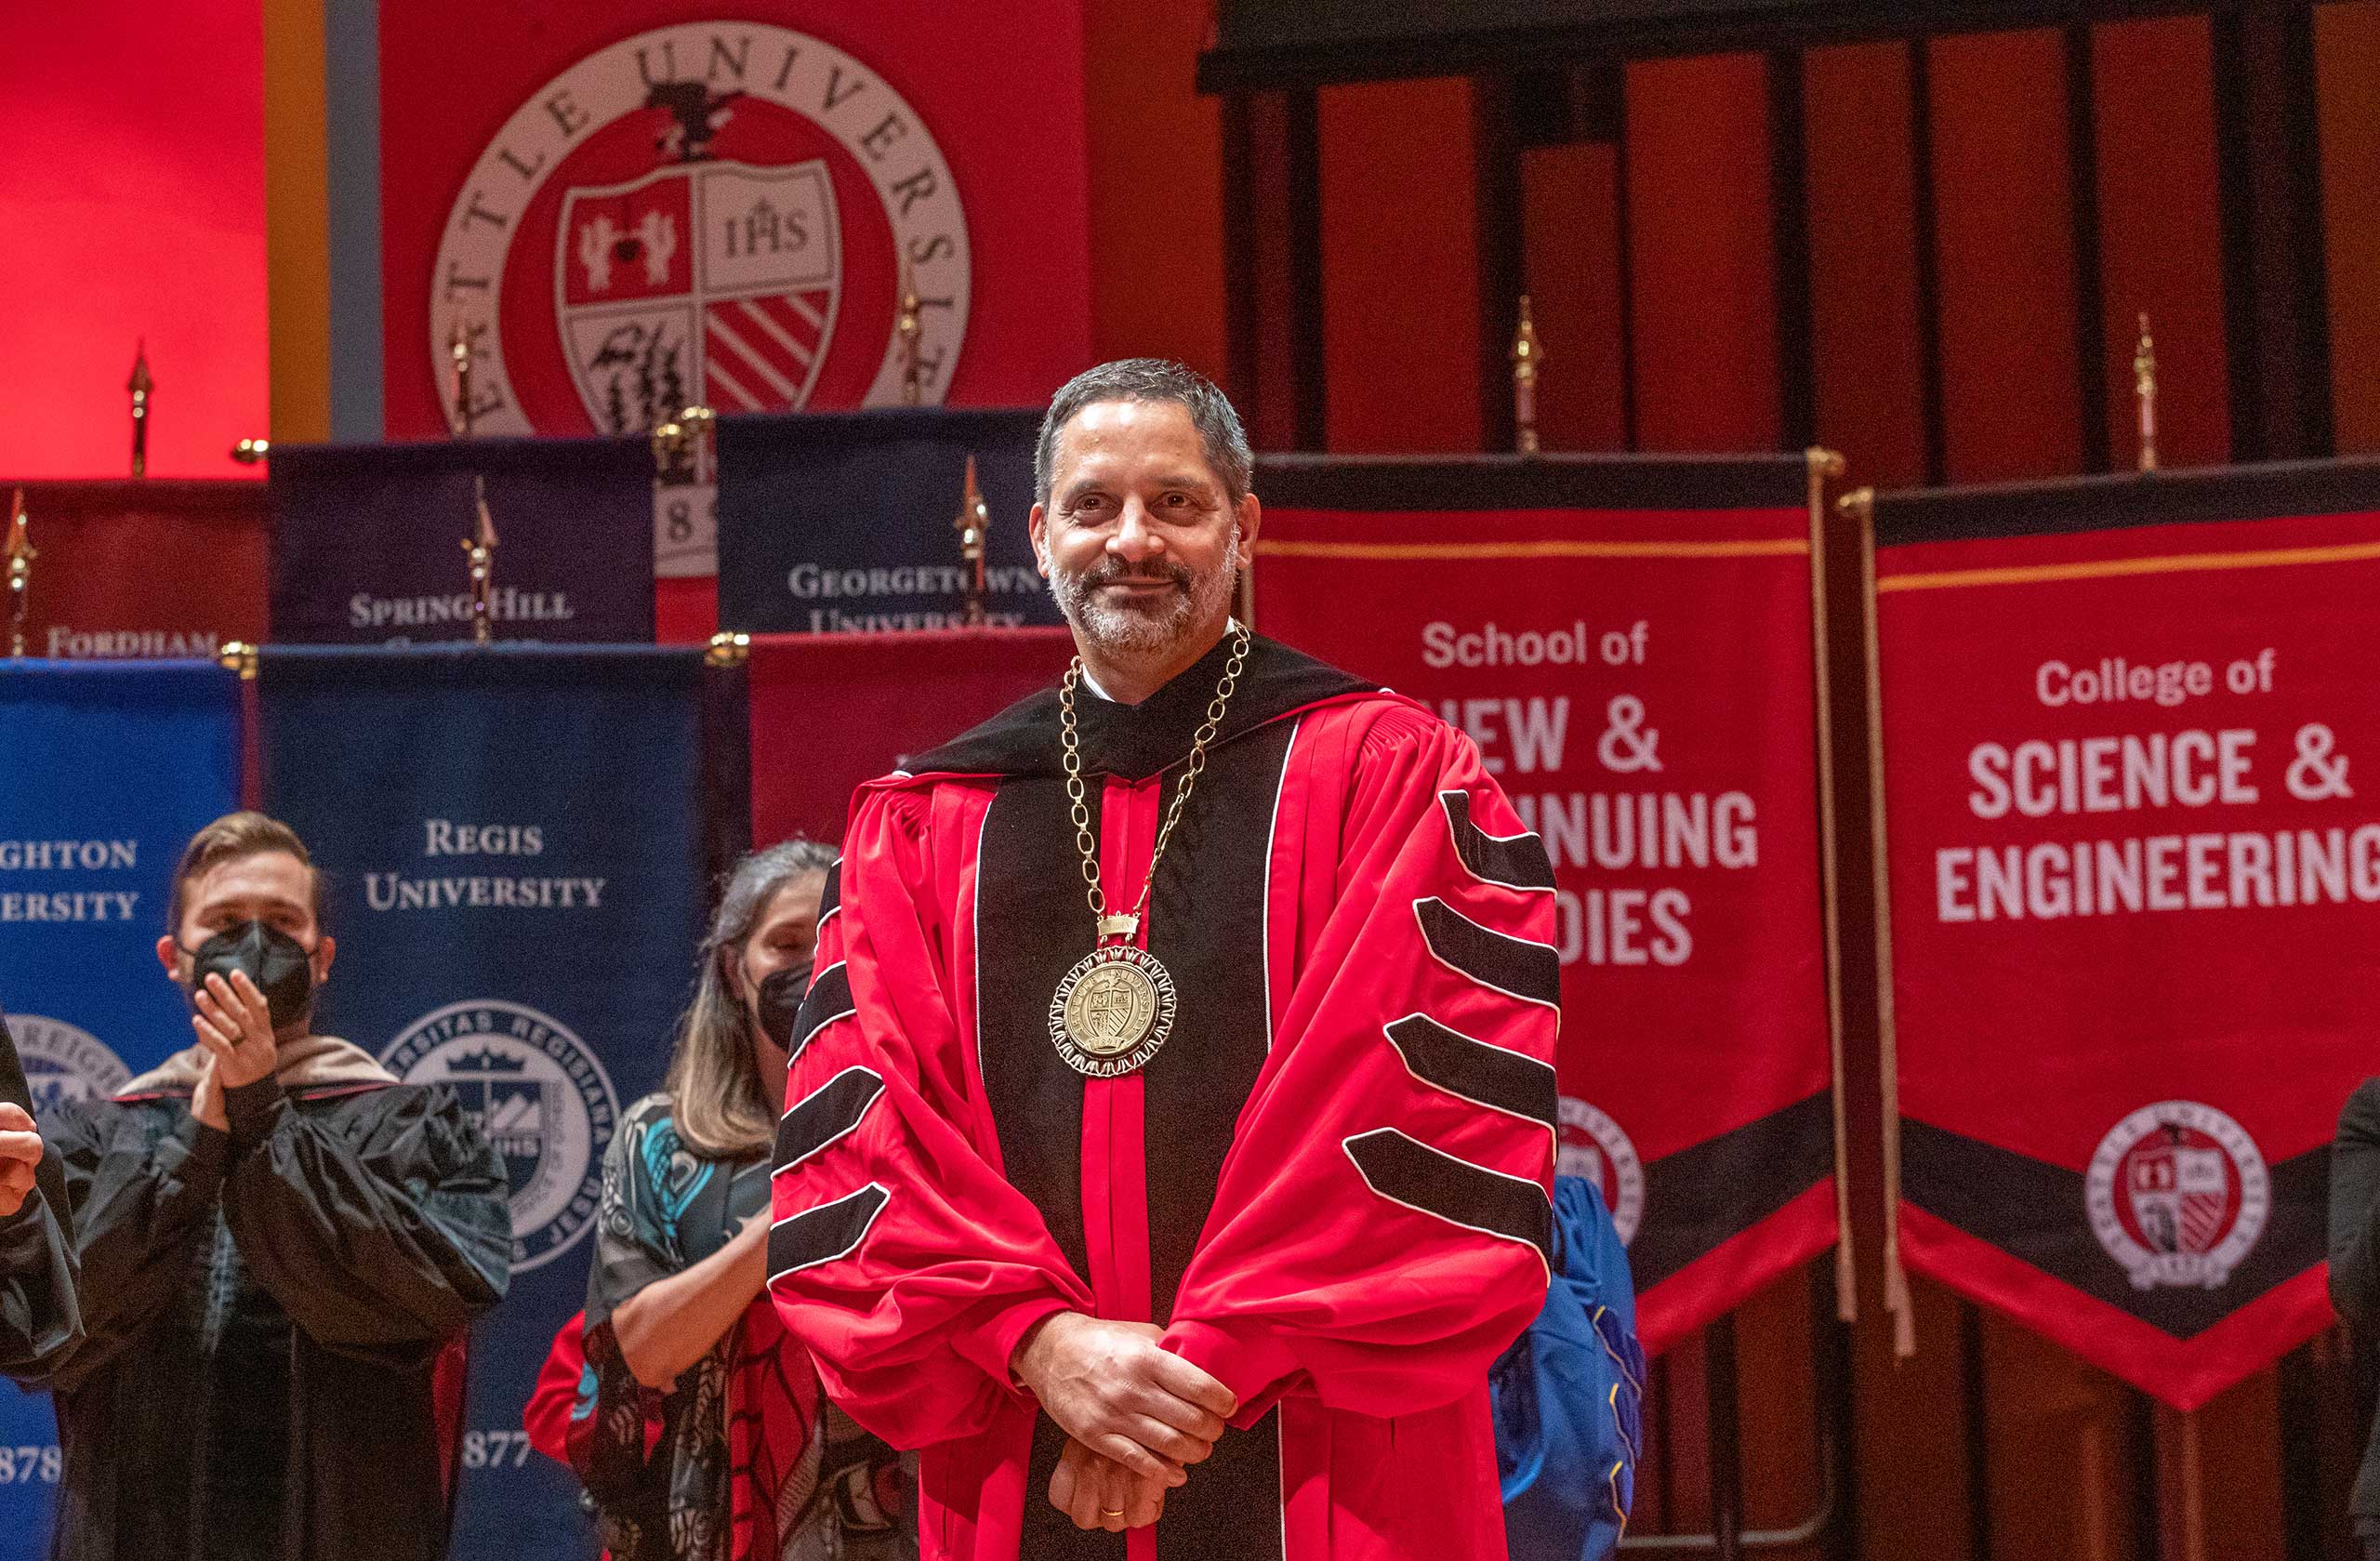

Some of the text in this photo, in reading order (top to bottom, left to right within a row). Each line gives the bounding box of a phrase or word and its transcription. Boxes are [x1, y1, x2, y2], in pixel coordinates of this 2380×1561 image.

[445, 34, 956, 422] EATTLE UNIVERSIT
[489, 587, 574, 620] HILL
[1421, 620, 1649, 668] School of
[2036, 647, 2278, 708] College of
[1596, 694, 1664, 774] &
[1967, 722, 2354, 821] SCIENCE &
[0, 840, 138, 871] GHTON
[424, 818, 544, 857] REGIS
[0, 891, 140, 922] ERSITY
[364, 871, 606, 912] UNIVERSITY
[1554, 887, 1695, 967] DIES
[0, 1445, 62, 1485] 878
[462, 1430, 532, 1469] 877
